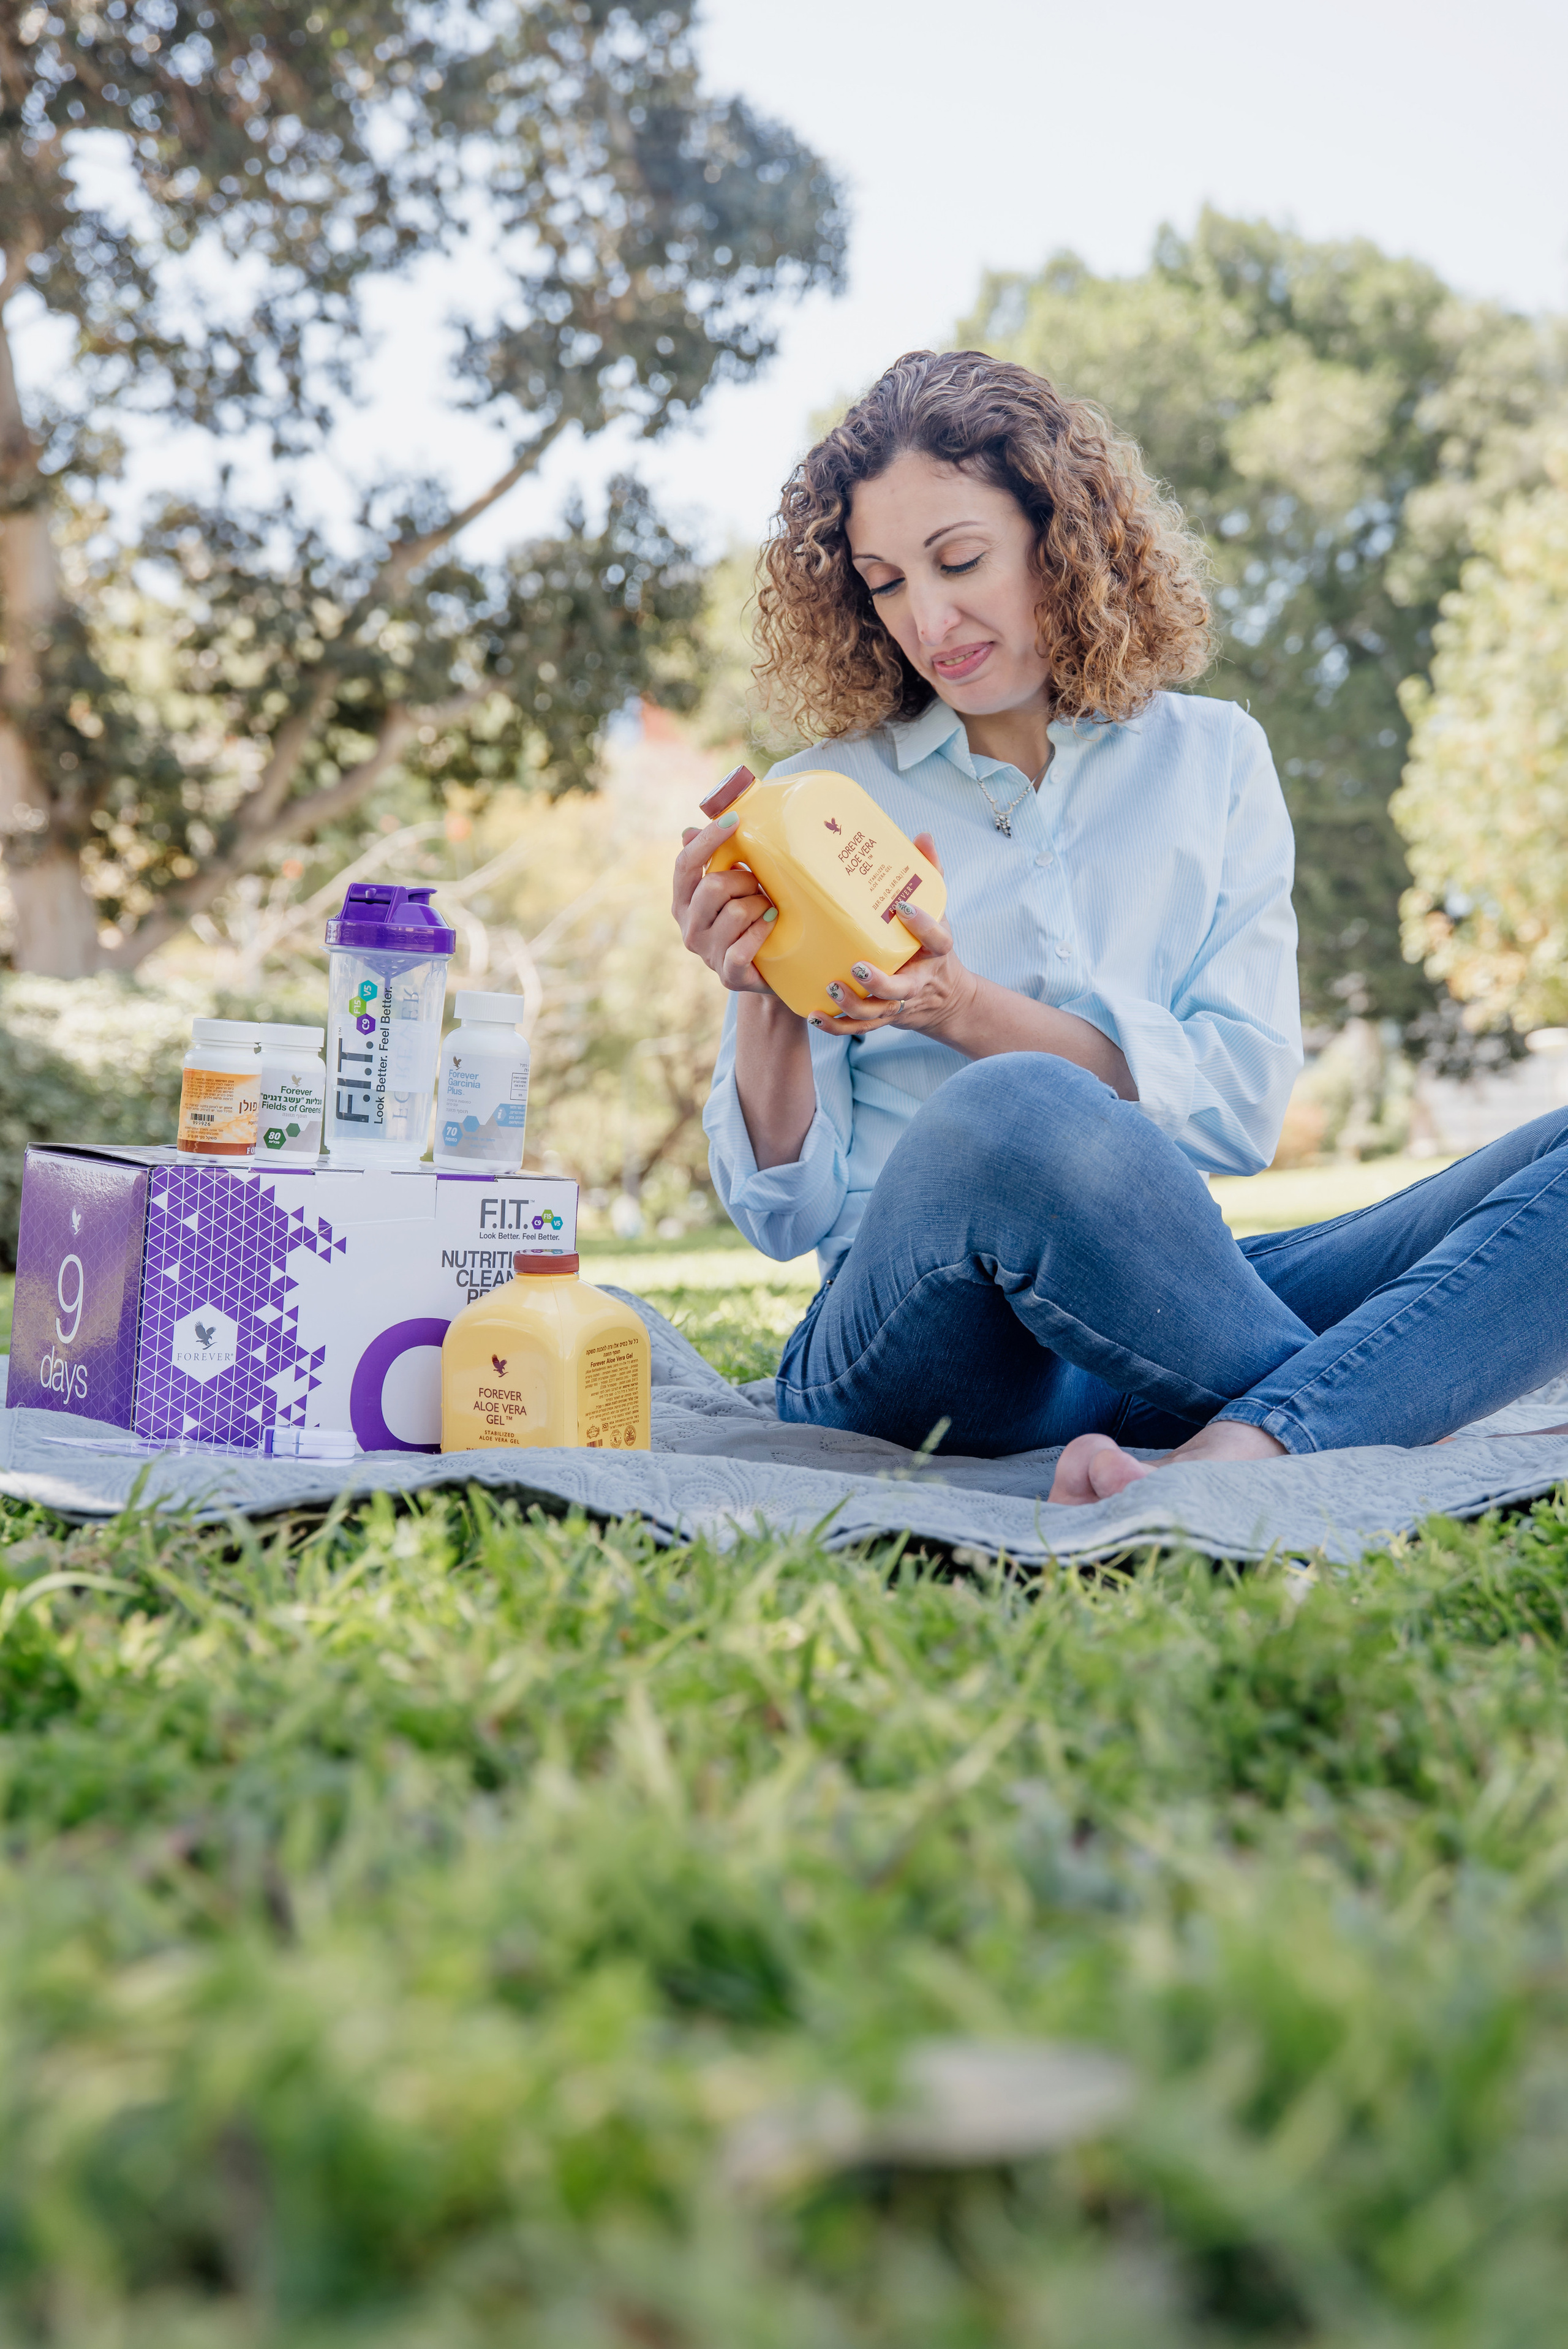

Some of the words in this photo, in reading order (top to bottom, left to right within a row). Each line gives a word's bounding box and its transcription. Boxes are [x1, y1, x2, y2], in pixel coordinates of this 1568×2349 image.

[838, 831, 865, 863] FOREVER
[845, 854, 862, 876] ALOE
[858, 839, 877, 857] VERA
[868, 864, 885, 884] STABILIZED
[878, 873, 886, 882] VERA
[363, 985, 372, 996] V5
[381, 986, 392, 1024] Better.
[362, 1018, 370, 1030] C9
[379, 1028, 390, 1051] Feel
[376, 1055, 388, 1093] Better.
[448, 1069, 479, 1080] Forever
[448, 1078, 481, 1088] Garcinia
[281, 1086, 312, 1096] Forever
[239, 1099, 257, 1114] פולן
[262, 1101, 286, 1110] Fields
[374, 1096, 385, 1124] Look
[447, 1126, 458, 1136] 70
[442, 1250, 515, 1269] NUTRITI
[56, 1254, 83, 1344] 9
[590, 1359, 605, 1367] Forever
[40, 1346, 88, 1404] days
[479, 1387, 522, 1401] FOREVER
[473, 1401, 499, 1412] ALOE
[502, 1404, 527, 1416] VERA
